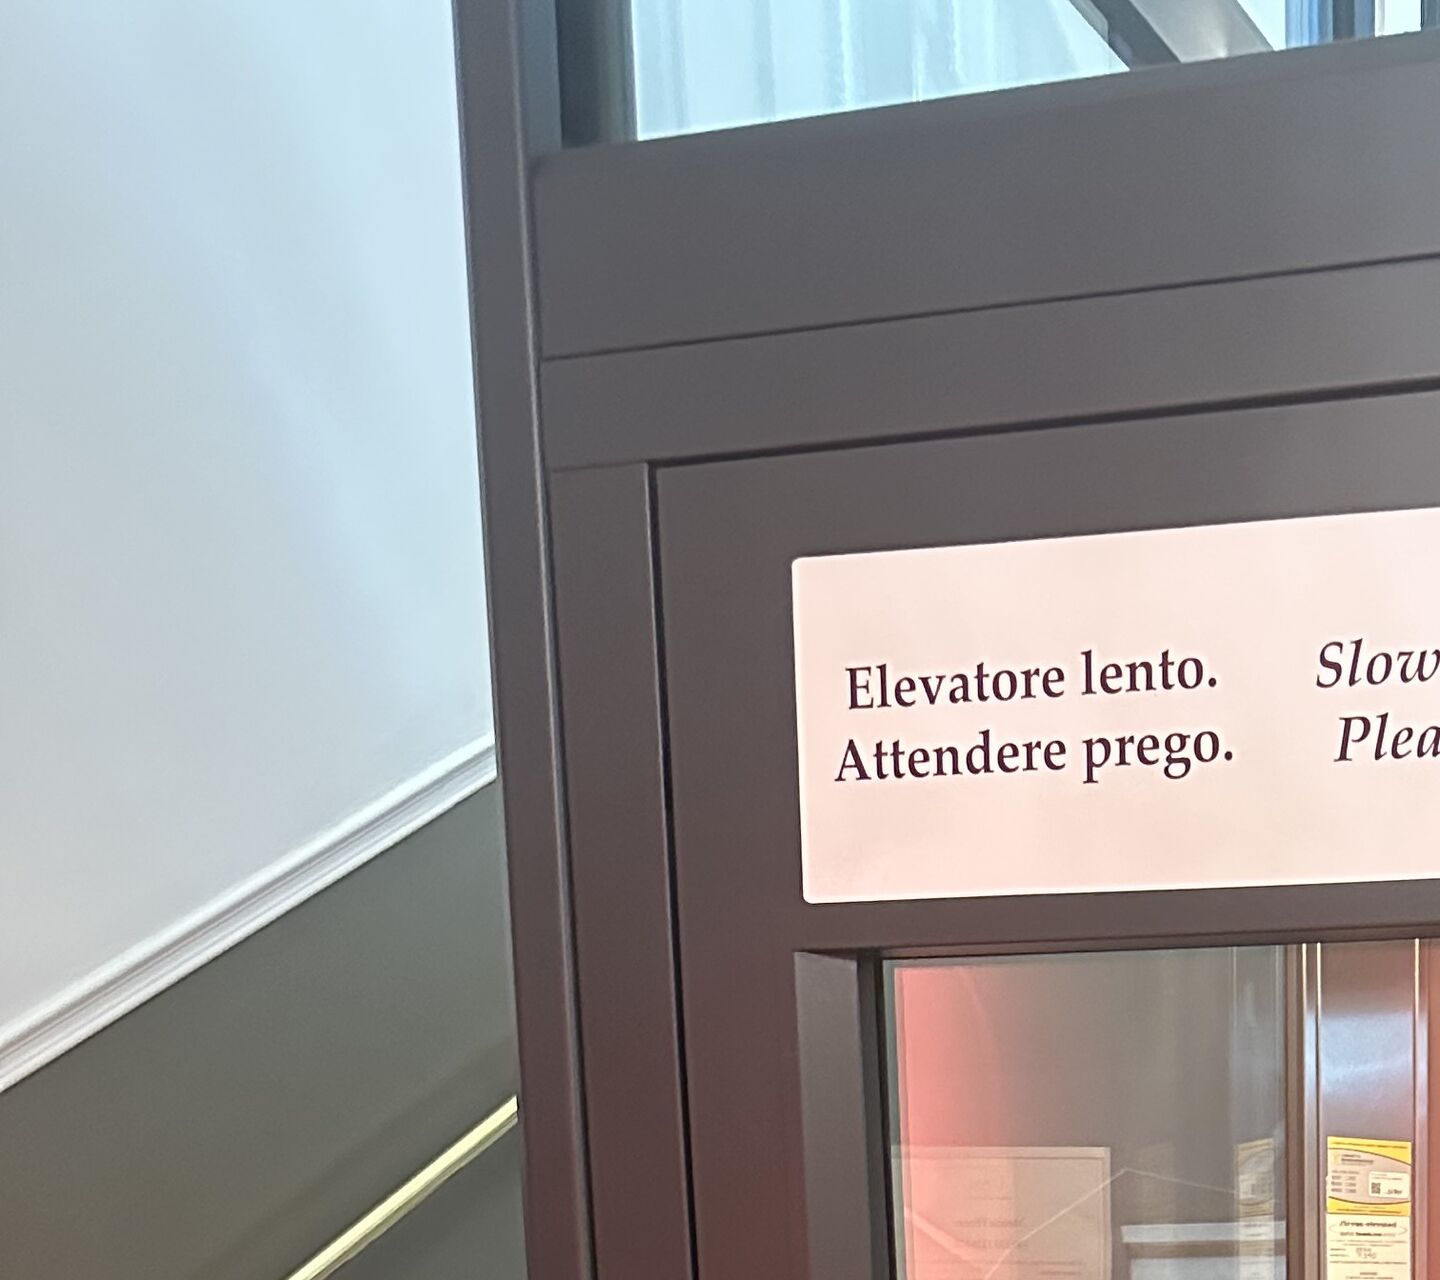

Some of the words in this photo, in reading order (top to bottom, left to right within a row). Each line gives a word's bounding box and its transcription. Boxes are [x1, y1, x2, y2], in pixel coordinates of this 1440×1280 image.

[845, 661, 1065, 711] Elevatore
[1080, 648, 1218, 697] lento.
[1315, 637, 1440, 690] Slow
[833, 728, 1067, 783] Attendere
[1081, 729, 1234, 785] prego.
